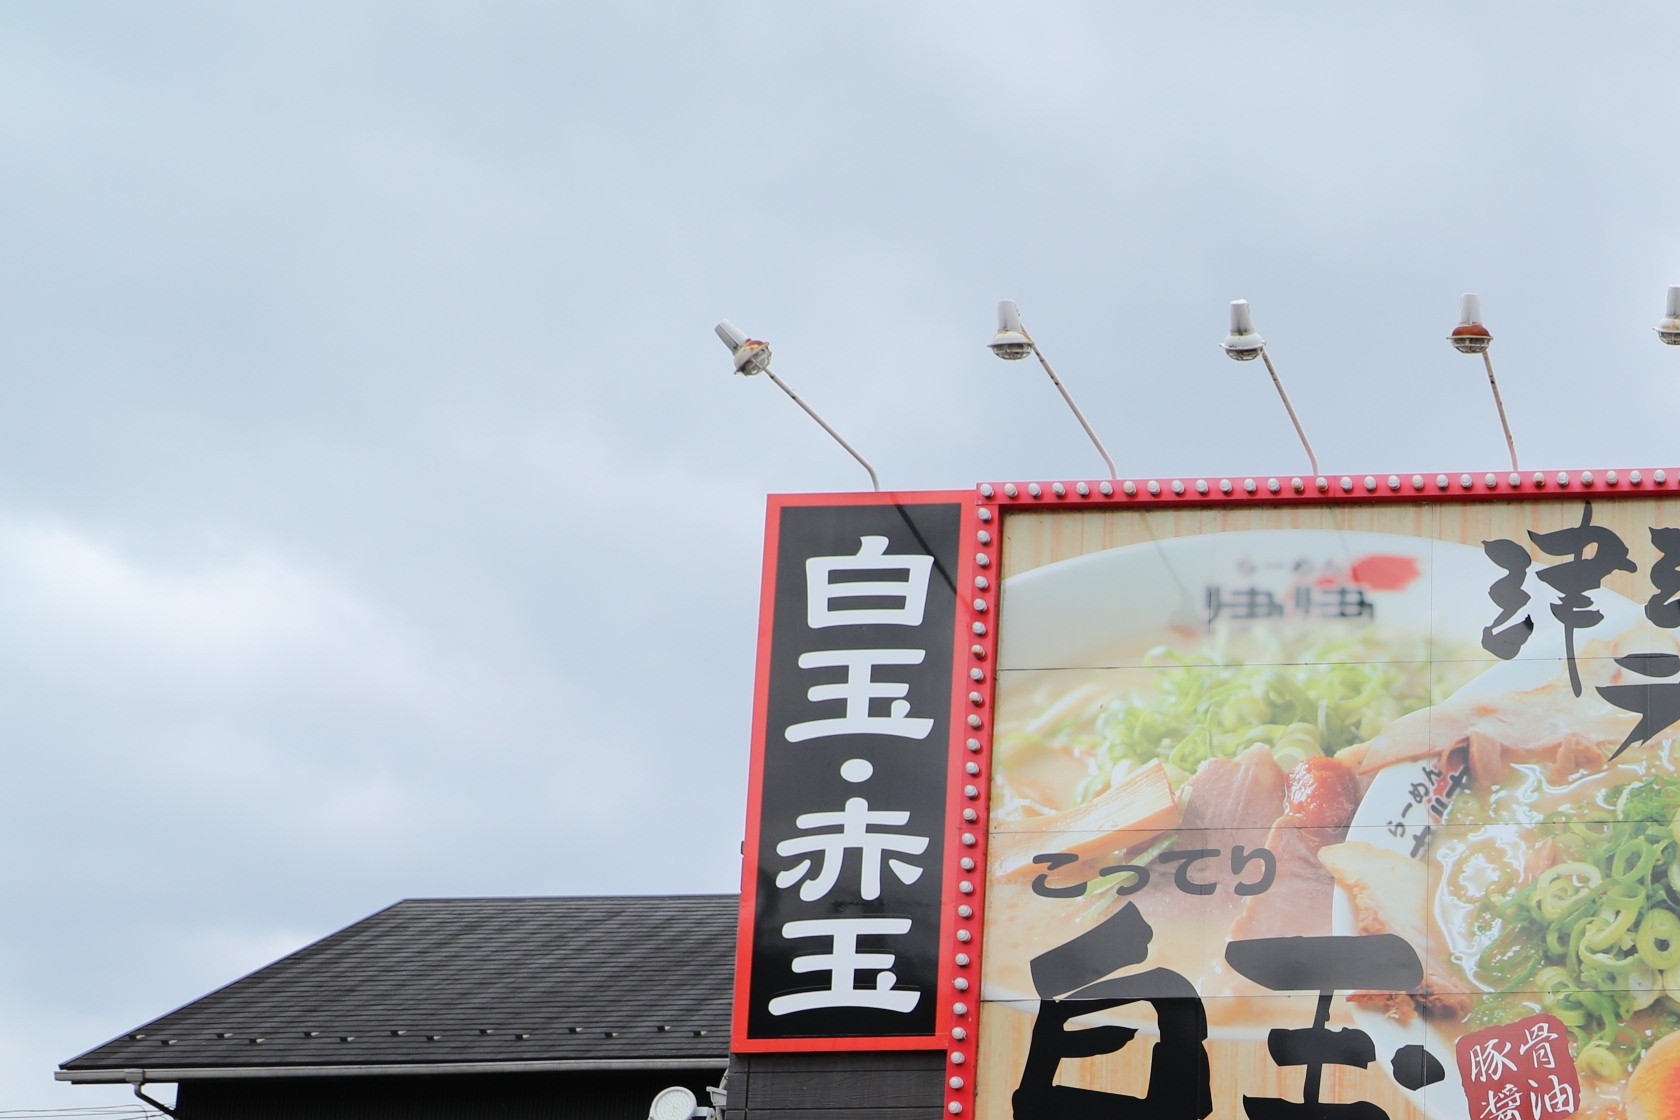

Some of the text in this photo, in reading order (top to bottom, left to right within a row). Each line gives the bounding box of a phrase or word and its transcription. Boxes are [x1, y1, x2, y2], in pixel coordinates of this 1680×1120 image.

[768, 535, 935, 1016] 白玉・赤玉
[1386, 766, 1443, 838] らーめん
[1030, 845, 1277, 898] こってり
[1469, 1022, 1558, 1082] 豚骨
